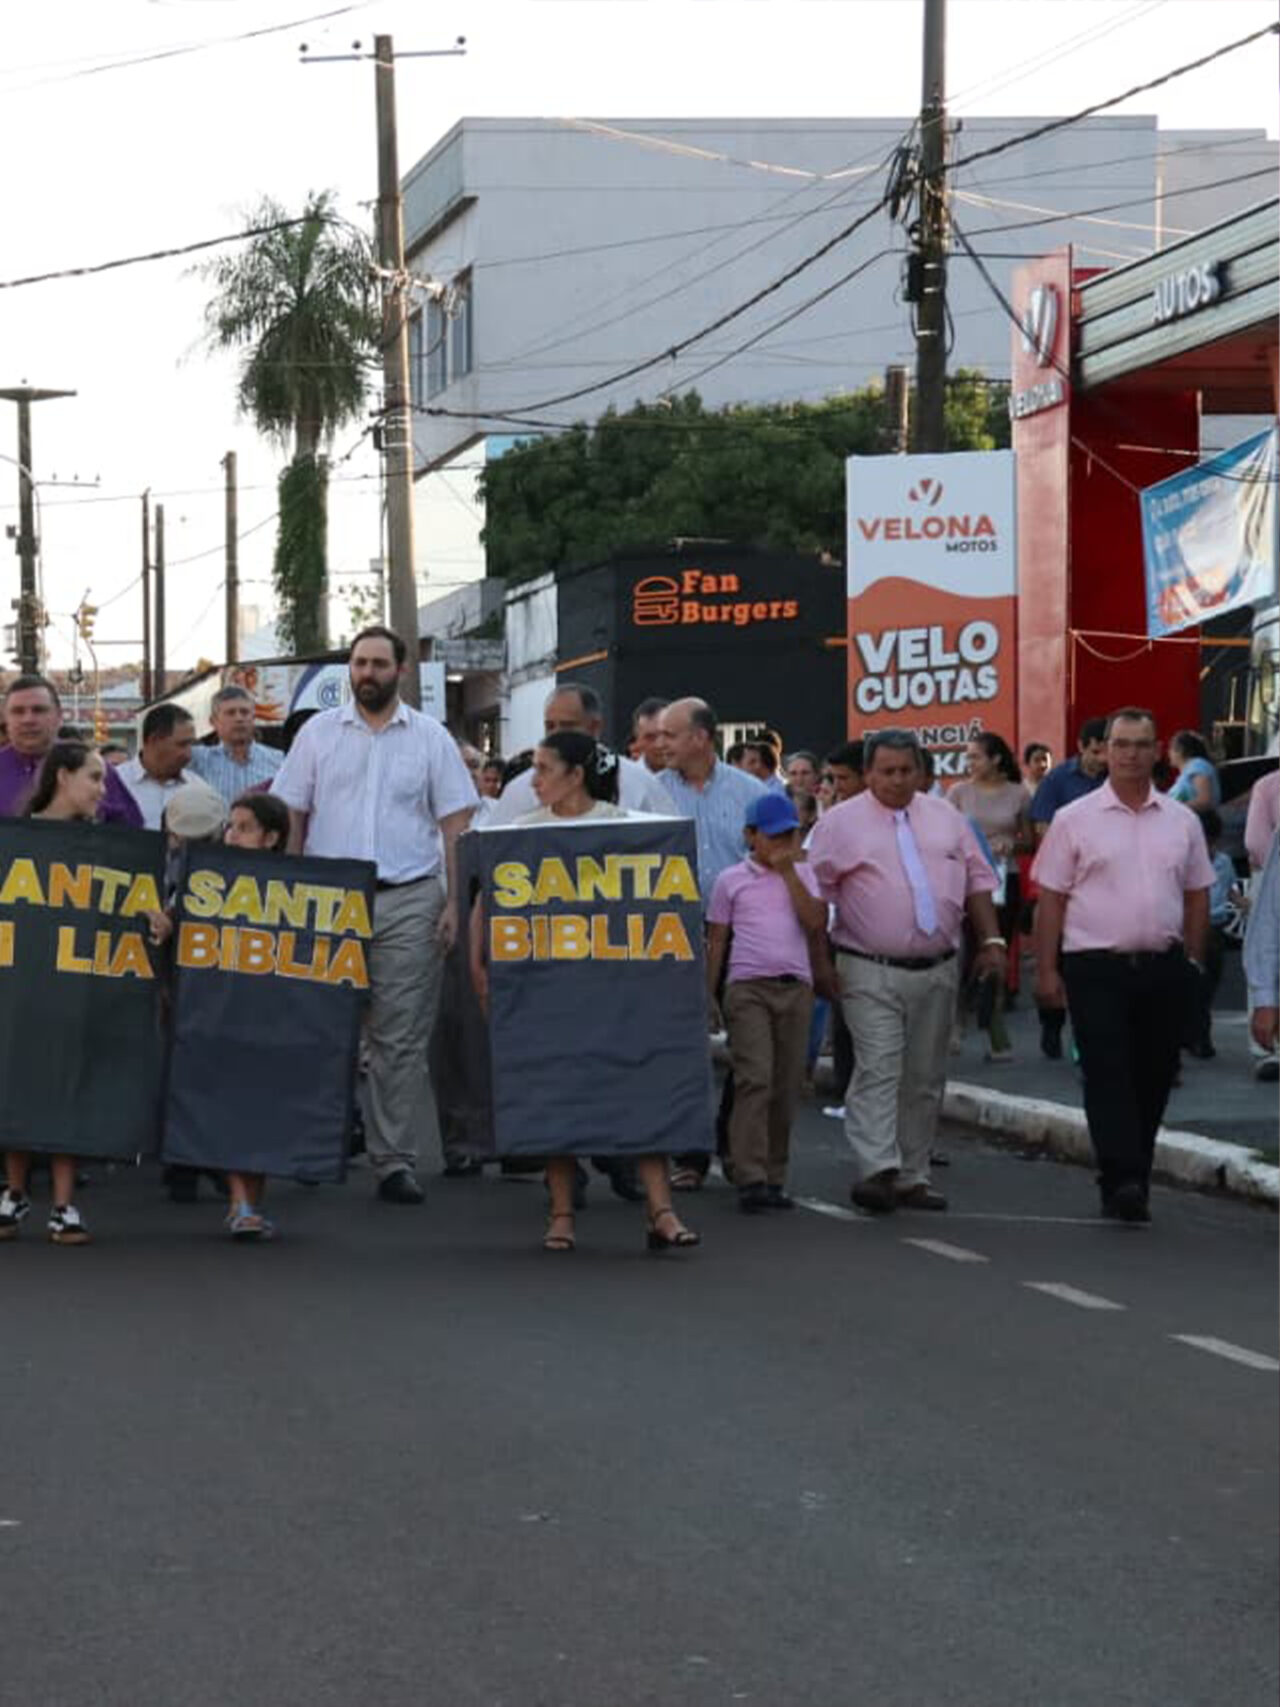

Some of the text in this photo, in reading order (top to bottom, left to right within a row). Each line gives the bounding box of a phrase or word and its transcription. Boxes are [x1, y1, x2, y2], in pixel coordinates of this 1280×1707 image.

[1152, 262, 1218, 323] AUTOS
[857, 514, 997, 542] VELONA
[945, 539, 998, 553] MOTOS
[681, 569, 739, 594] Fan
[681, 600, 799, 626] Burgers
[855, 620, 999, 674] VELO
[856, 664, 999, 713] CUOTAS
[183, 869, 373, 938] SANTA
[492, 854, 700, 908] SANTA
[176, 921, 370, 989] BIBLIA
[490, 912, 695, 961] BIBLIA
